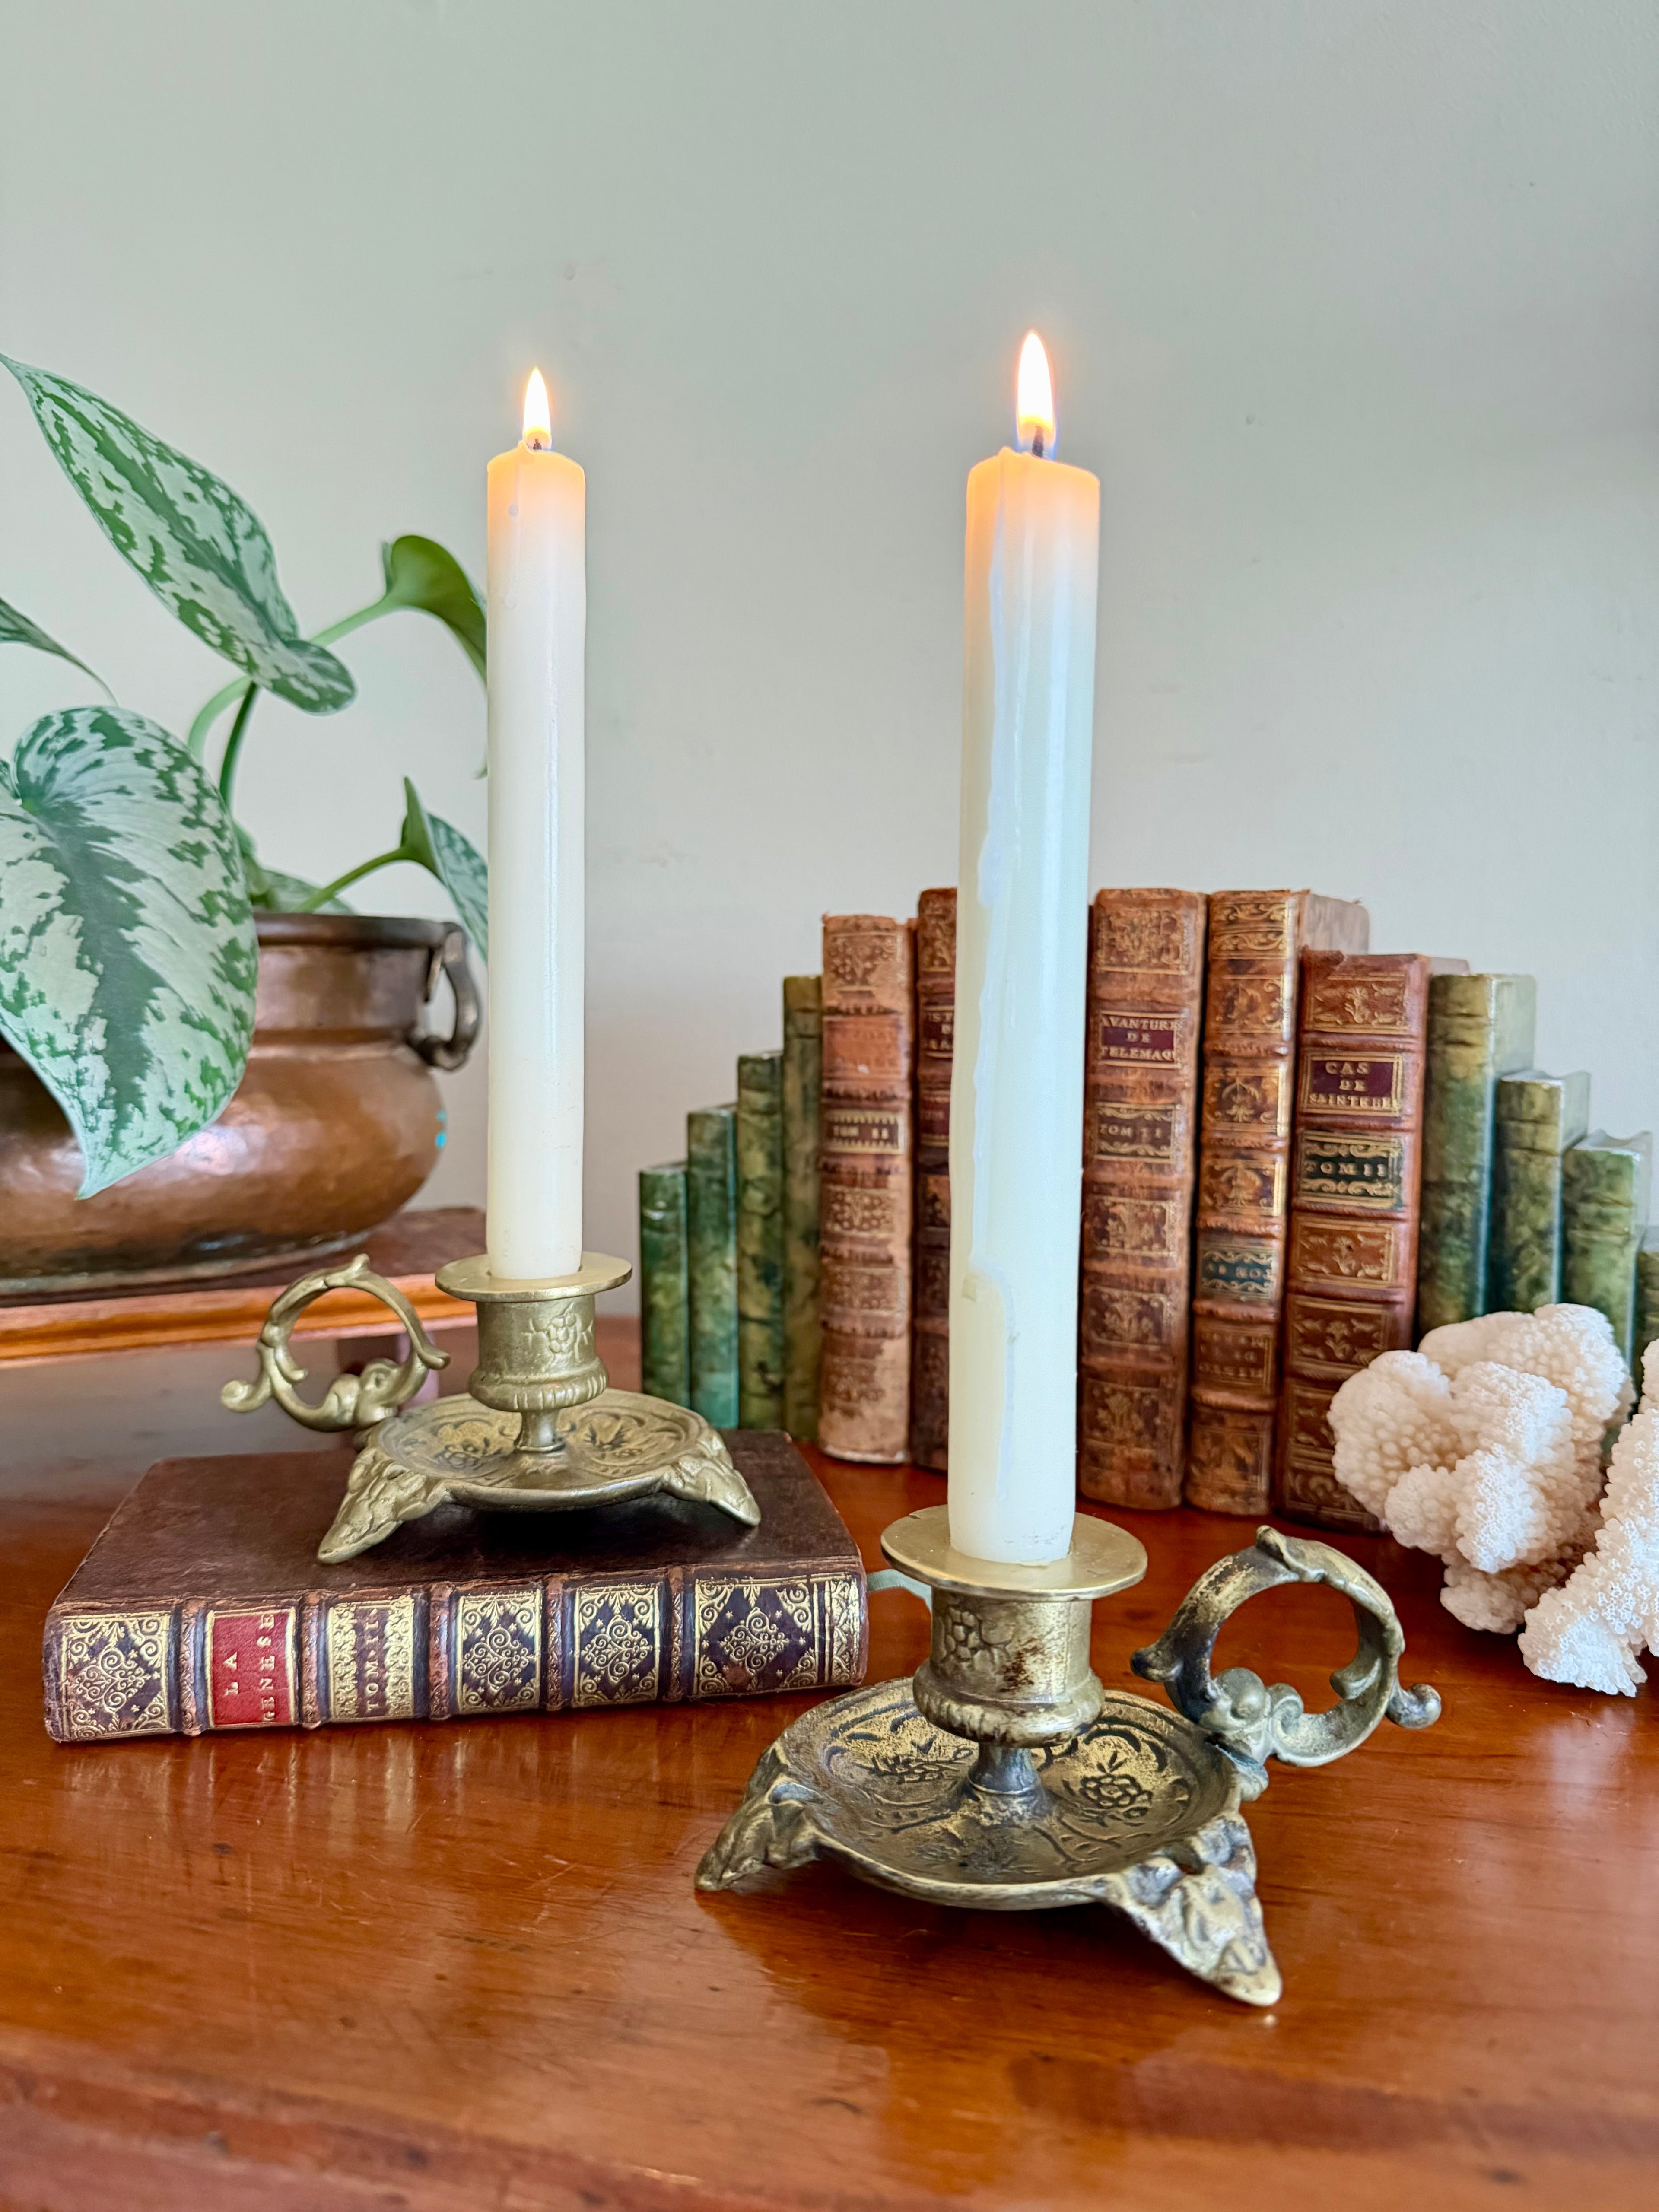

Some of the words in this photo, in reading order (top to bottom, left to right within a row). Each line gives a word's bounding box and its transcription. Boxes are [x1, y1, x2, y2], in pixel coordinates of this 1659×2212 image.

[1126, 1031, 1151, 1043] DE
[1325, 1062, 1370, 1075] CAS
[1339, 1080, 1367, 1092] DE
[223, 1651, 238, 1696] LA
[257, 1614, 276, 1722] GENESE
